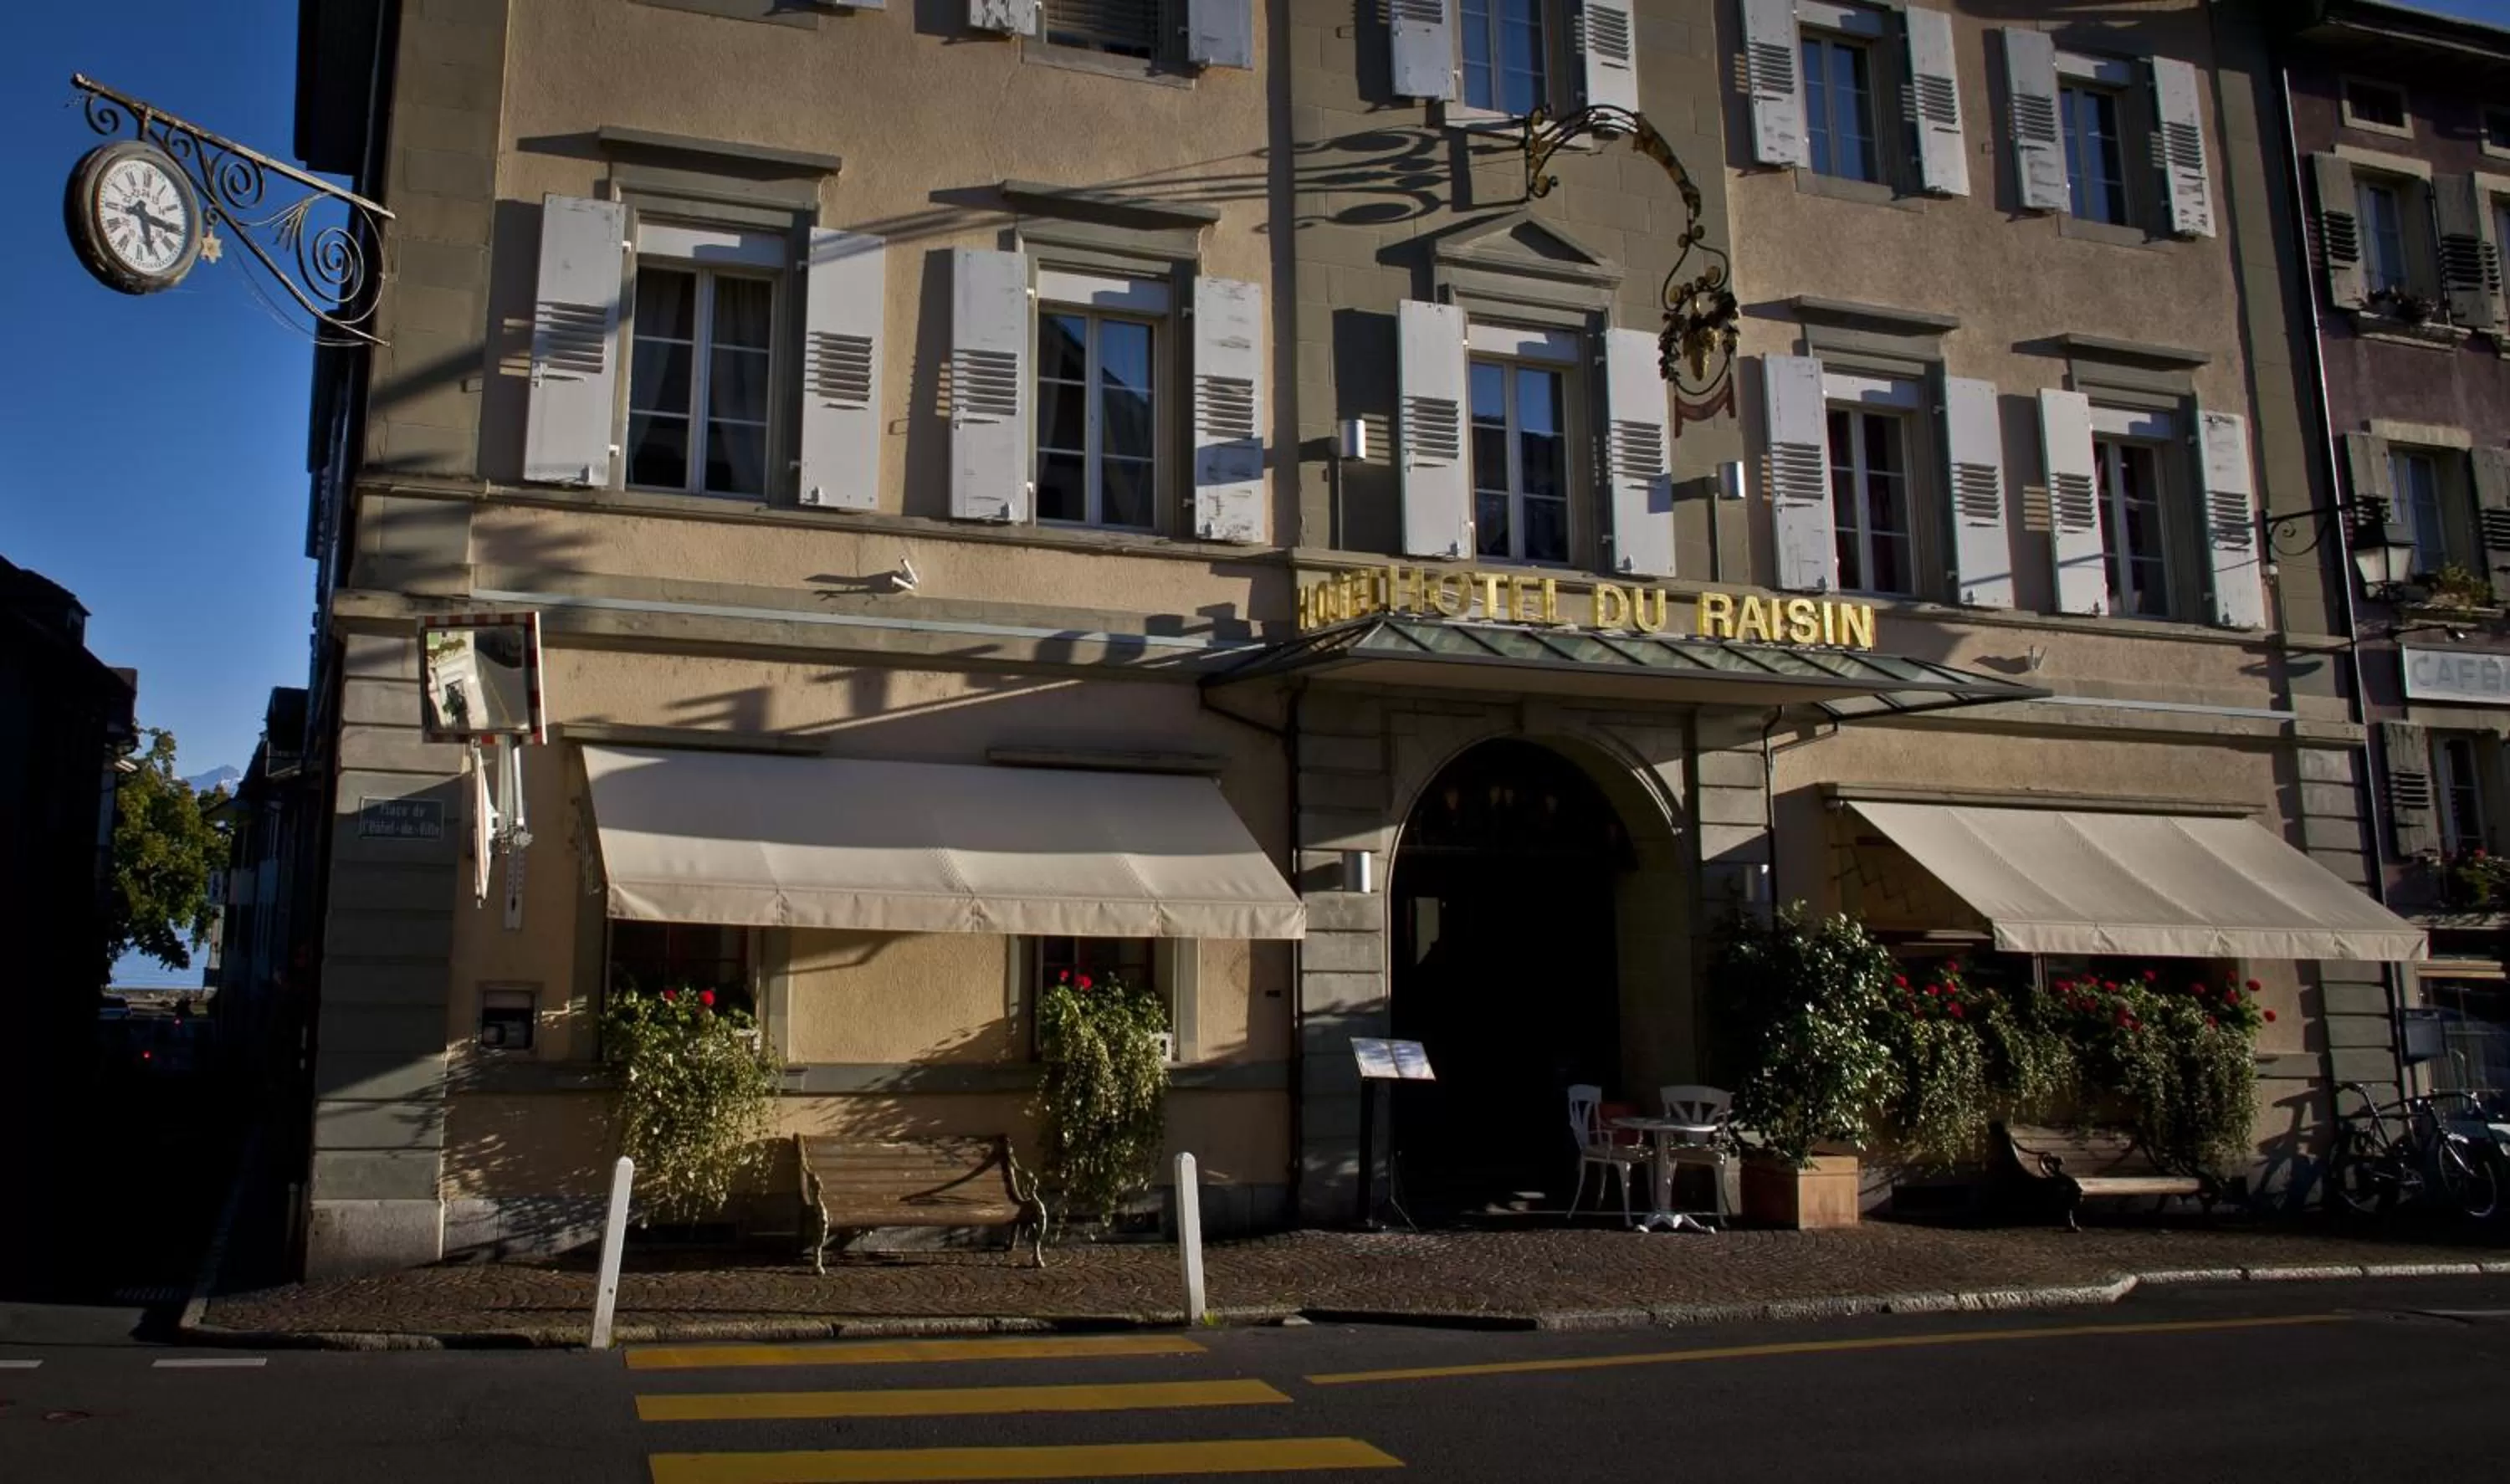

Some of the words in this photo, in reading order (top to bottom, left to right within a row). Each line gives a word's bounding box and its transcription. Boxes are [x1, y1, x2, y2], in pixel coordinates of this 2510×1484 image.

[1389, 564, 1574, 626] HOTEL
[1593, 582, 1667, 634] DU
[1698, 591, 1875, 651] RAISIN
